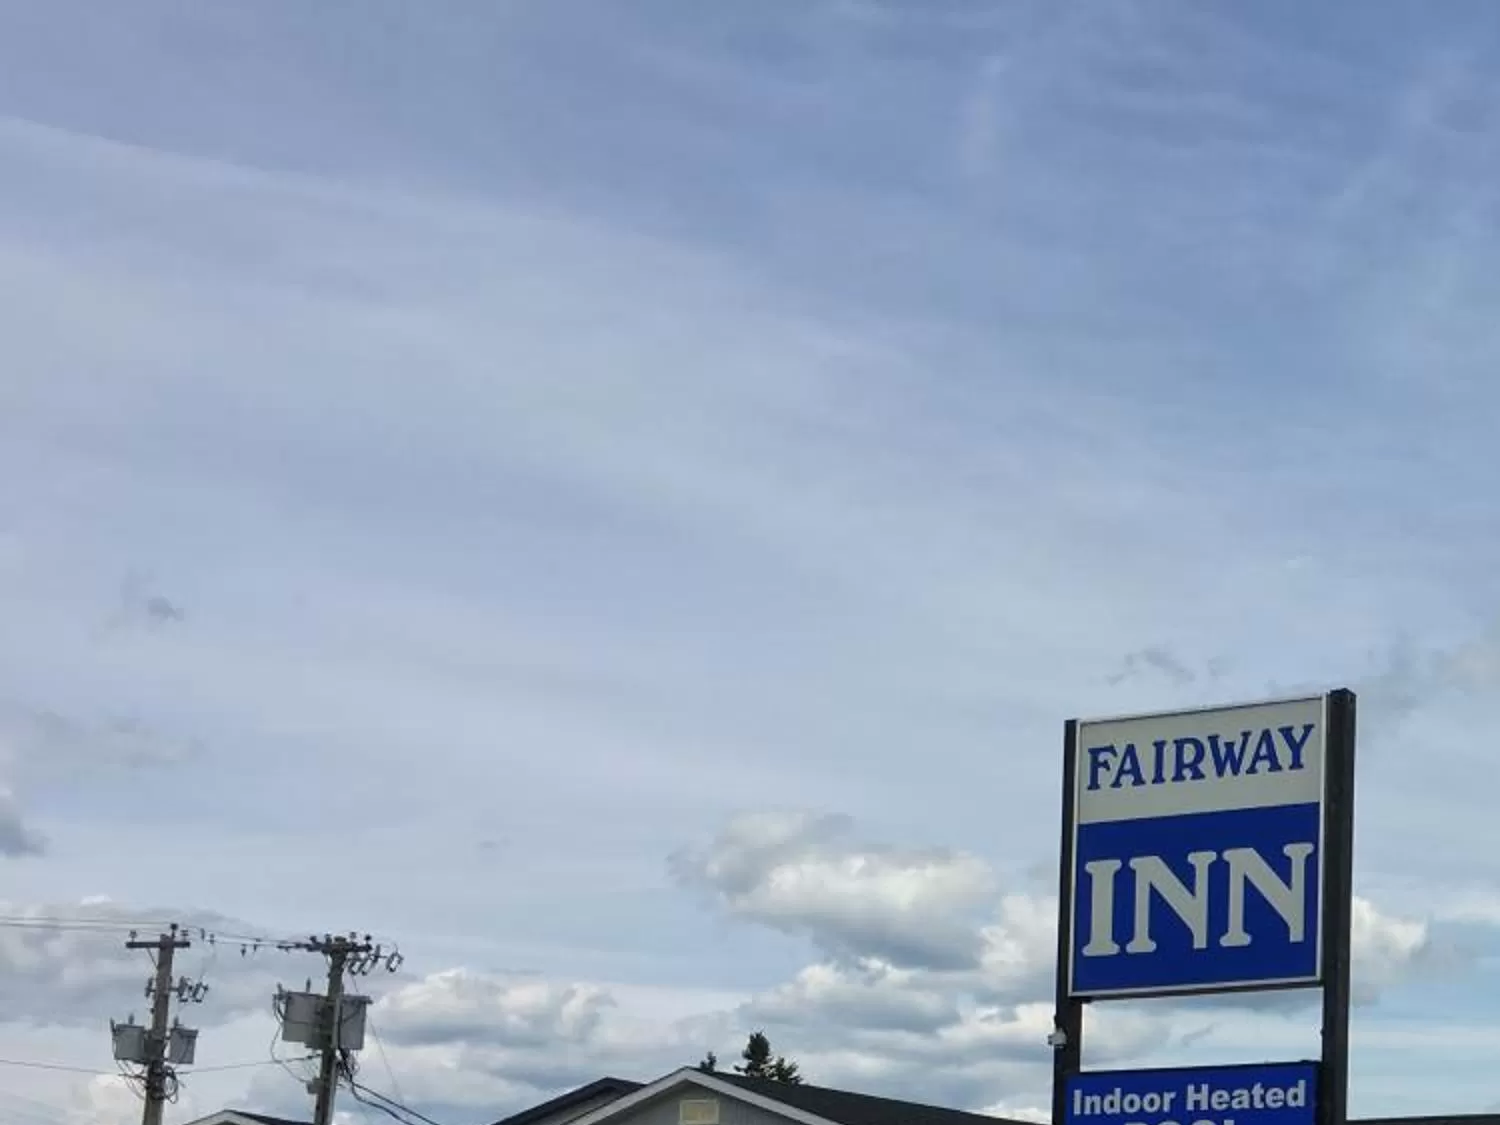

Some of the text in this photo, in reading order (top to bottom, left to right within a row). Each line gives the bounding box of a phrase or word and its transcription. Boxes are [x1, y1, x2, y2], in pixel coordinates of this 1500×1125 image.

[1086, 723, 1315, 791] FAIRWAY
[1081, 842, 1315, 957] INN
[1073, 1079, 1306, 1116] Indoor Heated
